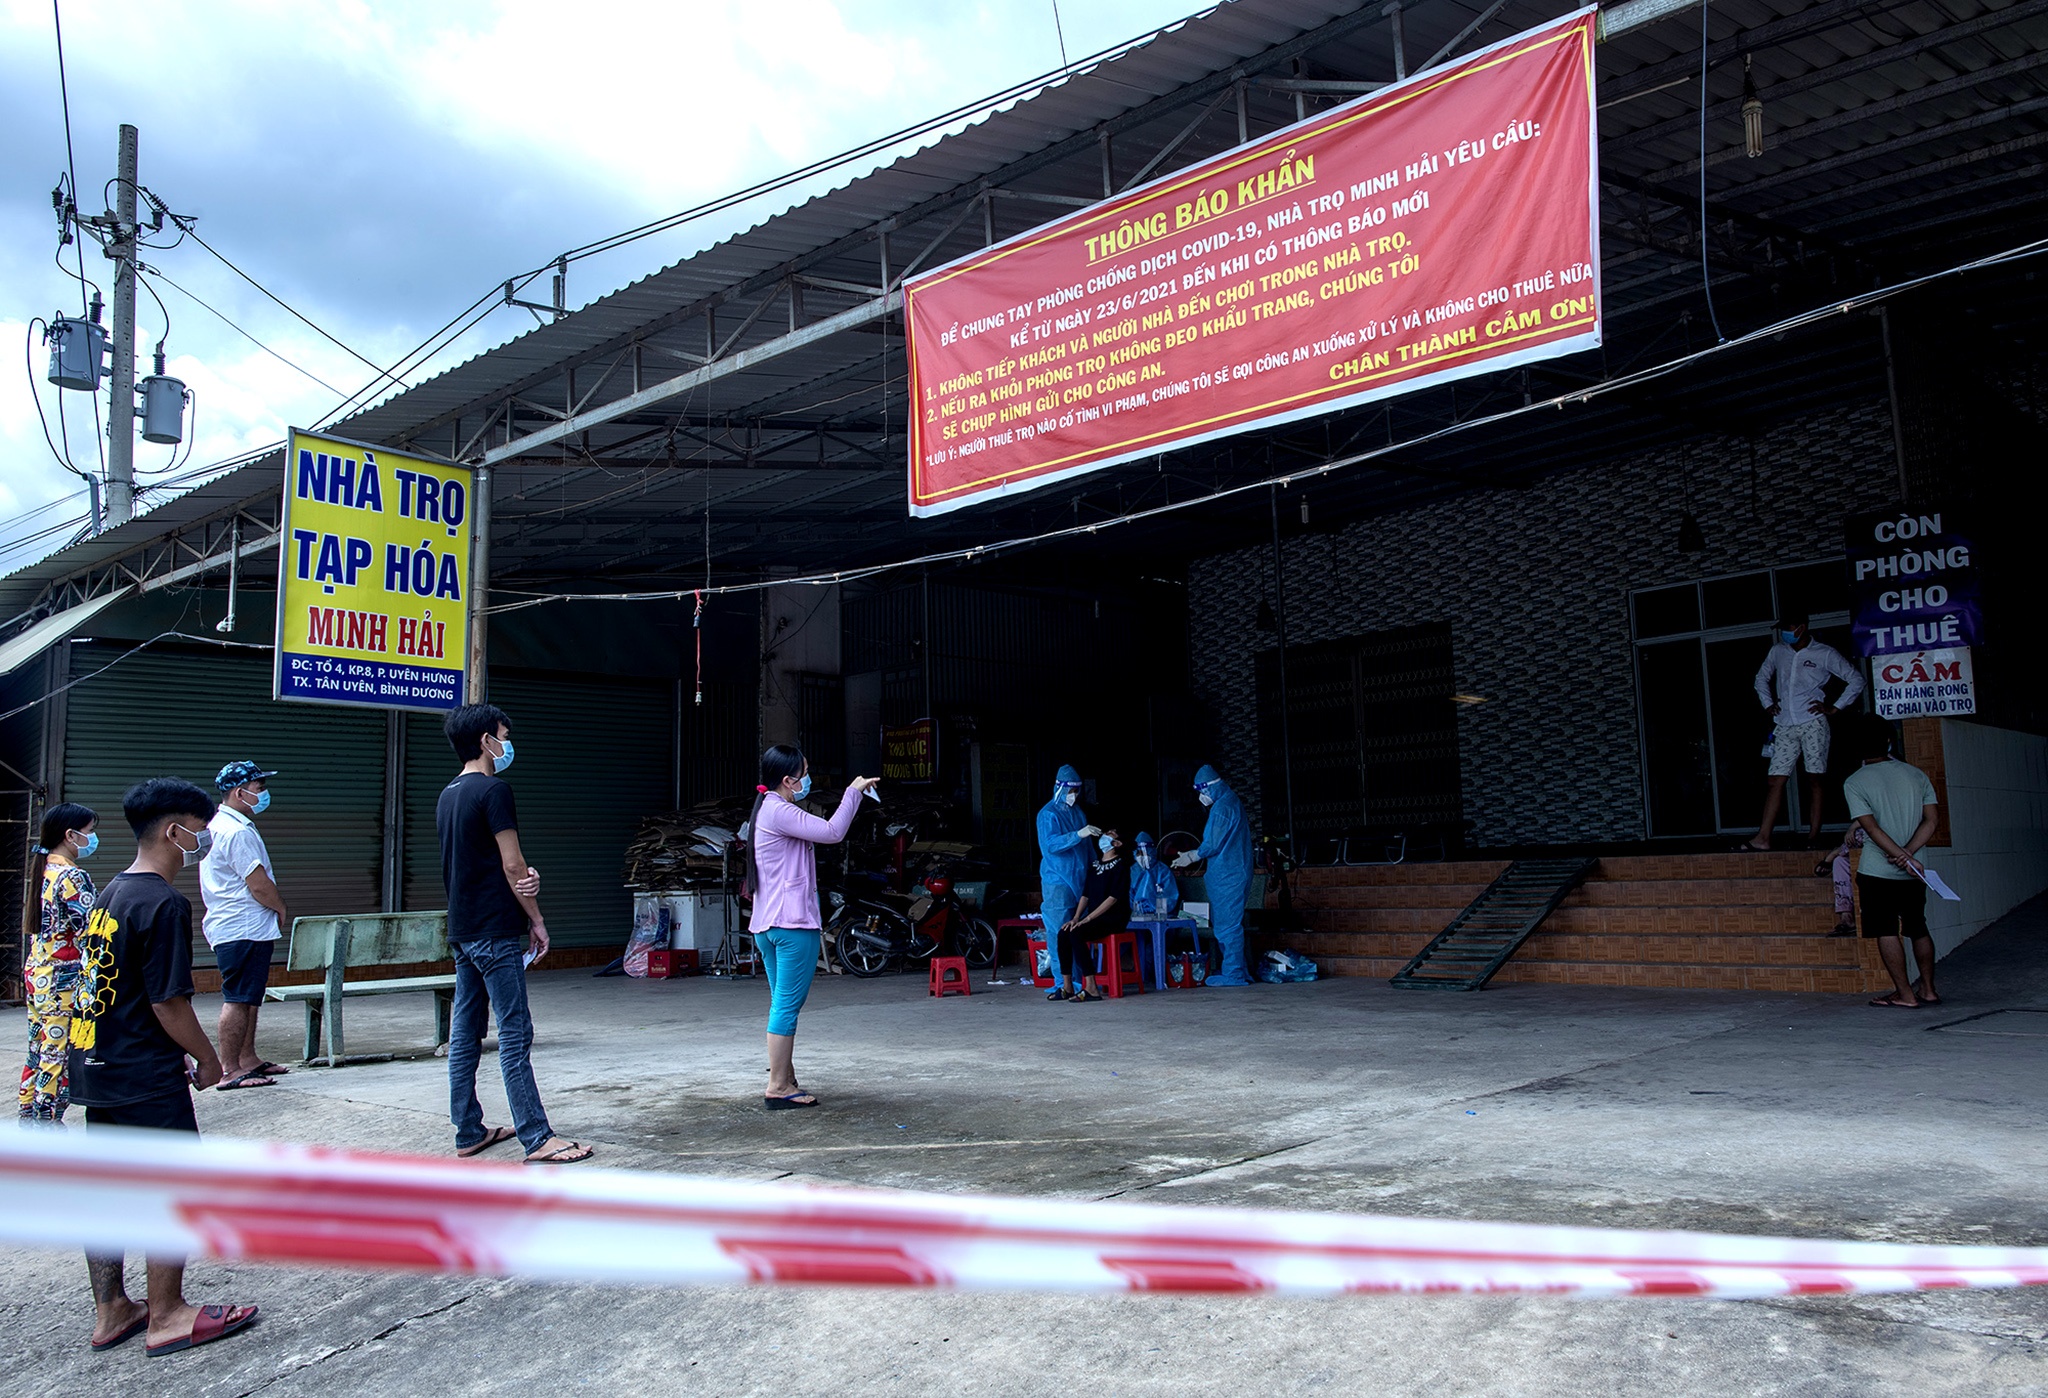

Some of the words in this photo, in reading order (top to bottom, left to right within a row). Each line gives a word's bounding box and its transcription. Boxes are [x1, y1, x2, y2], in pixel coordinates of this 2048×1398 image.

[941, 323, 958, 347] ĐỂ
[961, 313, 1004, 339] CHUNG
[1007, 302, 1033, 322] TAY
[1037, 284, 1083, 312] PHÒNG
[1087, 264, 1137, 294] CHỐNG
[1140, 250, 1177, 276] DỊCH
[1182, 221, 1262, 261] COVID-19,
[1267, 202, 1303, 231] NHÀ
[1307, 190, 1345, 216] TRỌ
[1350, 170, 1399, 201] MINH
[1405, 152, 1439, 182] HẢI
[1444, 139, 1486, 168] YÊU
[1492, 118, 1541, 150] CẦU:
[1084, 213, 1167, 261] THÔNG
[1175, 189, 1228, 229] BÁO
[1238, 149, 1315, 206] KHẨN
[1010, 323, 1029, 348] KỂ
[1033, 319, 1051, 340] TỪ
[1056, 309, 1092, 333] NGÀY
[1097, 280, 1178, 320] 23/6/2021
[1183, 262, 1216, 290] ĐẾN
[1221, 254, 1250, 277] KHI
[1255, 243, 1278, 265] CÓ
[1282, 221, 1343, 256] THÔNG
[1348, 207, 1386, 234] BÁO
[1392, 189, 1430, 219] MỚI
[926, 387, 937, 401] 1.
[939, 370, 983, 396] KHÔNG
[986, 357, 1016, 381] TIẾP
[1019, 344, 1066, 370] KHÁCH
[1070, 334, 1089, 355] VÀ
[1093, 317, 1137, 348] NGƯỜI
[1142, 310, 1174, 331] NHÀ
[1178, 292, 1211, 319] ĐẾN
[1215, 280, 1255, 307] CHƠI
[1259, 261, 1318, 292] TRONG
[1323, 242, 1361, 272] NHÀ
[1366, 231, 1412, 257] TRỌ.
[927, 410, 938, 423] 2.
[941, 395, 965, 418] NẾU
[970, 392, 987, 410] RA
[990, 379, 1022, 402] KHỎI
[1027, 368, 1072, 392] PHÒNG
[1076, 355, 1106, 376] TRỌ
[1110, 337, 1161, 367] KHÔNG
[1165, 326, 1198, 349] ĐEO
[1203, 305, 1247, 338] KHẨU
[1252, 290, 1315, 321] TRANG,
[1319, 268, 1384, 301] CHÚNG
[1388, 254, 1420, 277] TÔI
[1329, 351, 1390, 380] CHÂN
[1396, 326, 1476, 362] THÀNH
[1486, 310, 1542, 338] CẢM
[1550, 293, 1595, 320] ƠN!
[948, 447, 957, 460] Ý:
[959, 438, 986, 458] NGƯỜI
[988, 429, 1013, 448] THUÊ
[1015, 425, 1035, 441] TRỌ
[1037, 418, 1056, 435] NÀO
[1059, 410, 1074, 427] CỐ
[1076, 406, 1099, 424] TÌNH
[1102, 402, 1112, 415] VI
[1115, 393, 1149, 412] PHẠM,
[1152, 376, 1189, 402] CHÚNG
[1192, 371, 1212, 390] TÔI
[1214, 366, 1230, 385] SẼ
[1233, 361, 1253, 380] GỌI
[1255, 350, 1289, 373] CÔNG
[1292, 345, 1309, 361] AN
[1313, 326, 1355, 357] XUỐNG
[1359, 319, 1378, 344] XỬ
[1381, 315, 1399, 337] LÝ
[1402, 309, 1422, 331] VÀ
[1425, 299, 1474, 326] KHÔNG
[1478, 287, 1509, 308] CHO
[1513, 270, 1555, 297] THUÊ
[1560, 263, 1593, 286] NỮA
[943, 423, 958, 440] SẼ
[961, 414, 997, 435] CHỤP
[1000, 402, 1031, 424] HÌNH
[1035, 390, 1060, 411] GỬI
[1064, 384, 1092, 404] CHO
[1097, 370, 1136, 394] CÔNG
[1140, 363, 1166, 382] AN.
[296, 448, 384, 513] NHÀ
[395, 468, 466, 537] TRỌ
[1875, 513, 1941, 542] CÒN
[293, 529, 373, 594] TẠP
[384, 540, 461, 601] HÓA
[1856, 546, 1970, 581] PHÒNG
[1879, 585, 1948, 613] CHO
[308, 606, 388, 652] MINH
[398, 610, 446, 659] HẢI
[1870, 614, 1961, 648] THUÊ
[292, 659, 312, 671] ĐC:
[315, 659, 332, 672] TỔ
[335, 664, 345, 675] 4,
[349, 665, 374, 678] KP.8,
[378, 668, 386, 678] P.
[389, 668, 418, 681] UYÊN
[422, 672, 455, 684] HƯNG
[292, 676, 311, 687] TX.
[315, 676, 339, 690] TÂN
[343, 679, 376, 694] UYÊN,
[380, 682, 408, 696] BÌNH
[412, 687, 453, 699] DƯƠNG
[1880, 686, 1900, 701] BÁN
[1905, 685, 1934, 698] HÀNG
[1939, 683, 1968, 696] RONG
[1882, 652, 1961, 683] CẤM
[1880, 704, 1893, 715] VE
[1897, 702, 1921, 714] CHAI
[1925, 699, 1947, 712] VÀO
[1949, 698, 1972, 711] TRỌ
